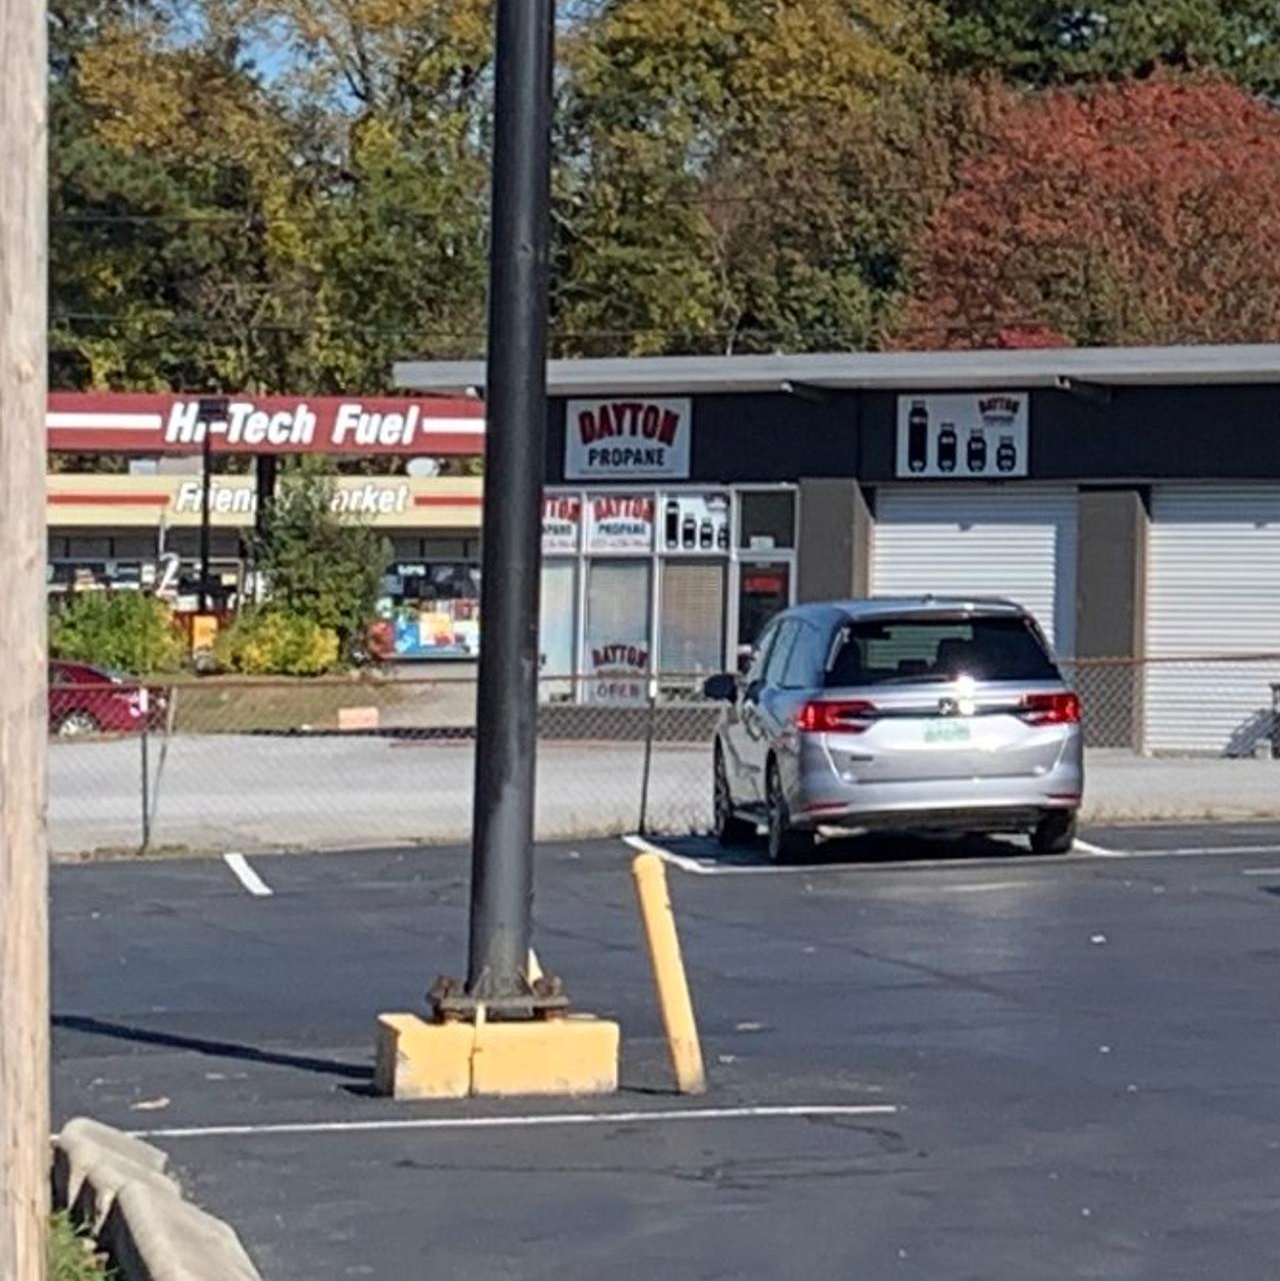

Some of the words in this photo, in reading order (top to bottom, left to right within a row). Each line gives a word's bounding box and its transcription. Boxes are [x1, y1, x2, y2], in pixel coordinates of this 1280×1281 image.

[331, 404, 420, 446] Fuel
[578, 402, 681, 447] DAYTON
[587, 447, 666, 467] PROPANE
[308, 484, 408, 514] arket
[593, 497, 655, 524] DAYTON
